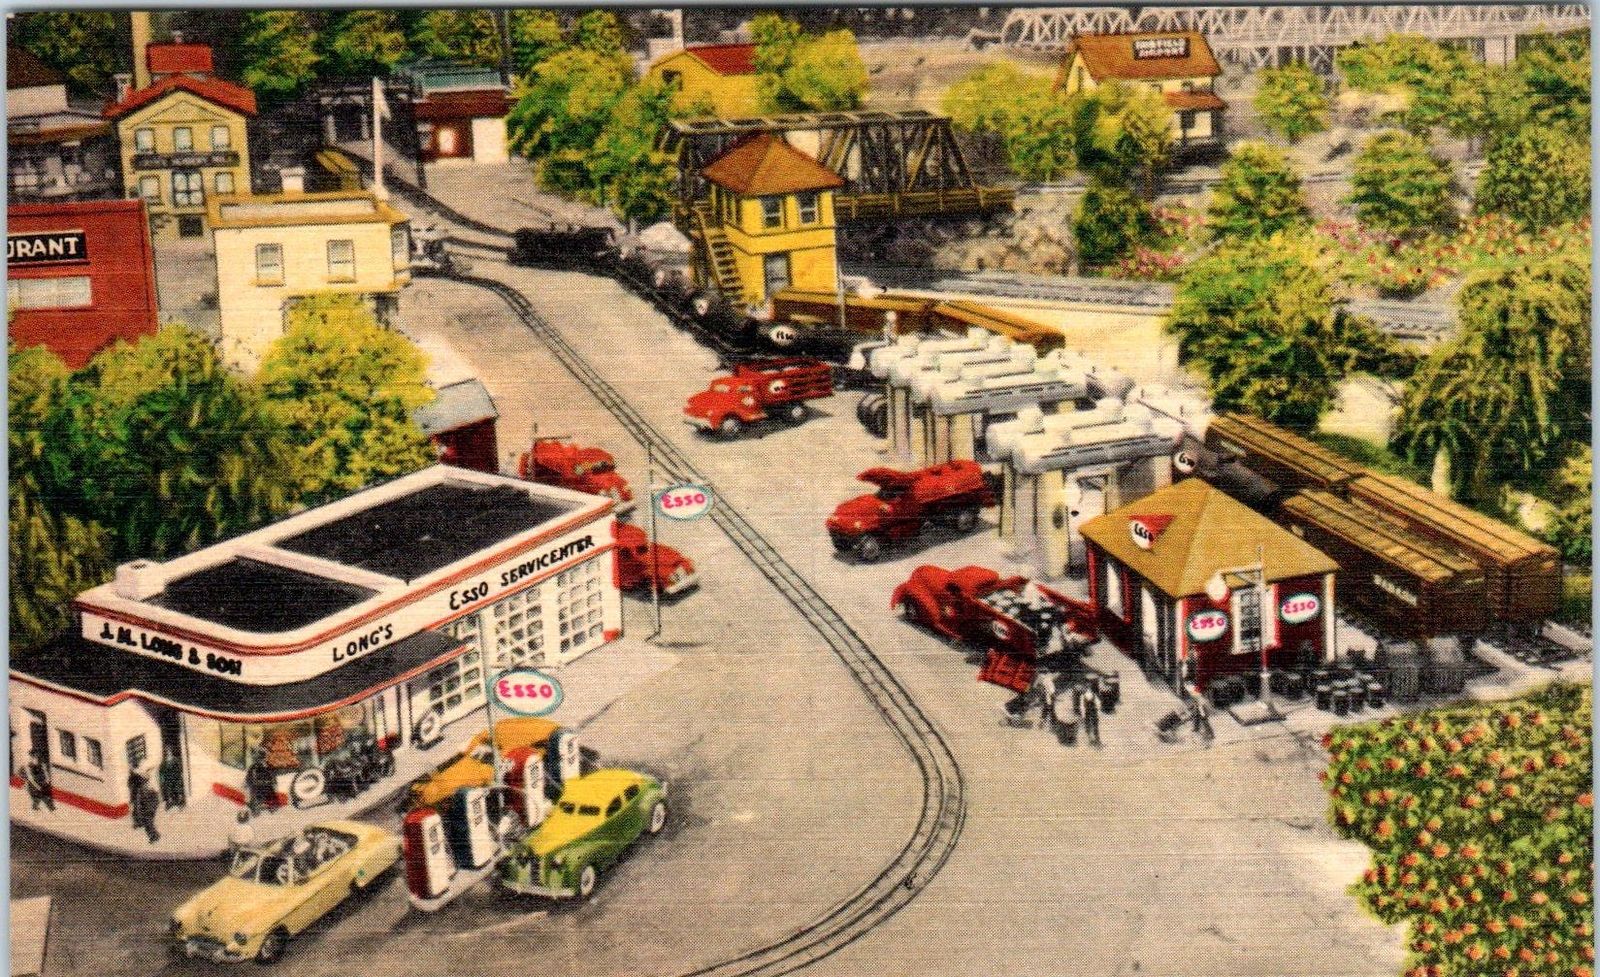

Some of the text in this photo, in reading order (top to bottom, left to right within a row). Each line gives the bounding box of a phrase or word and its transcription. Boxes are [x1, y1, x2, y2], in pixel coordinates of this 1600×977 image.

[332, 623, 394, 663] LONG'S
[500, 535, 596, 587] SERVICENTER
[141, 633, 183, 660] LONG
[188, 647, 200, 665] &
[206, 653, 242, 676] SON
